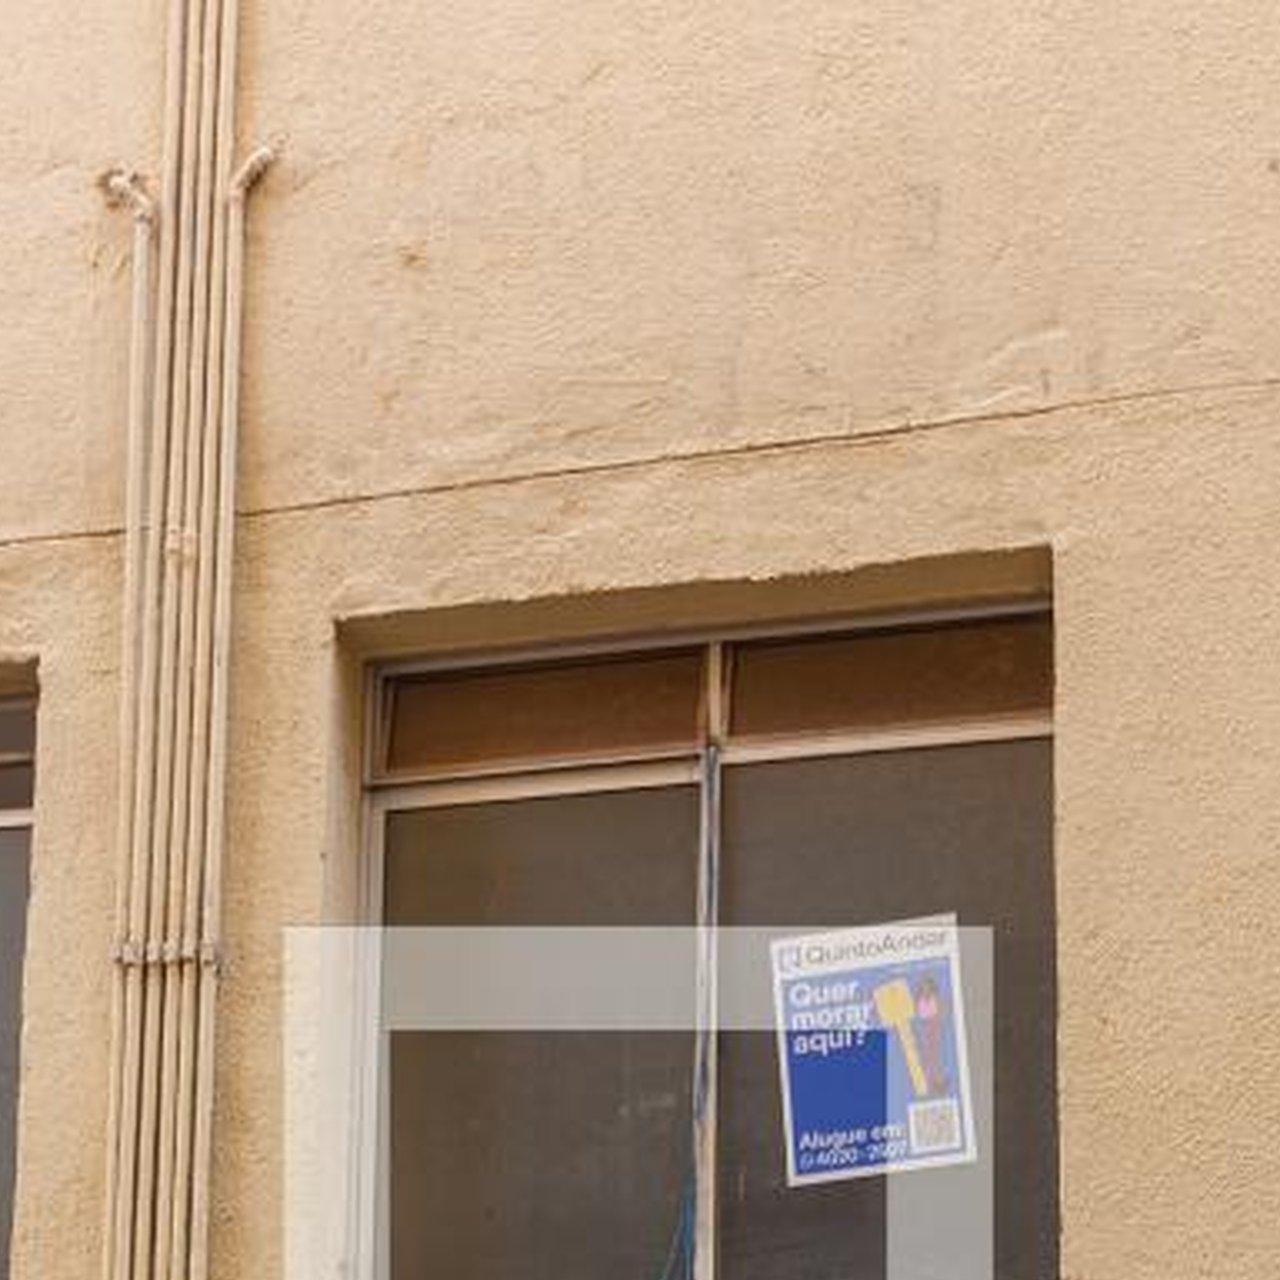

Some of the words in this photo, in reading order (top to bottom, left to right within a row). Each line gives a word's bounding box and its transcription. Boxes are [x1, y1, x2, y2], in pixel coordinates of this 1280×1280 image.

[806, 933, 946, 963] QuintoAndar
[790, 981, 859, 1005] Quer
[794, 1029, 865, 1056] aqui?
